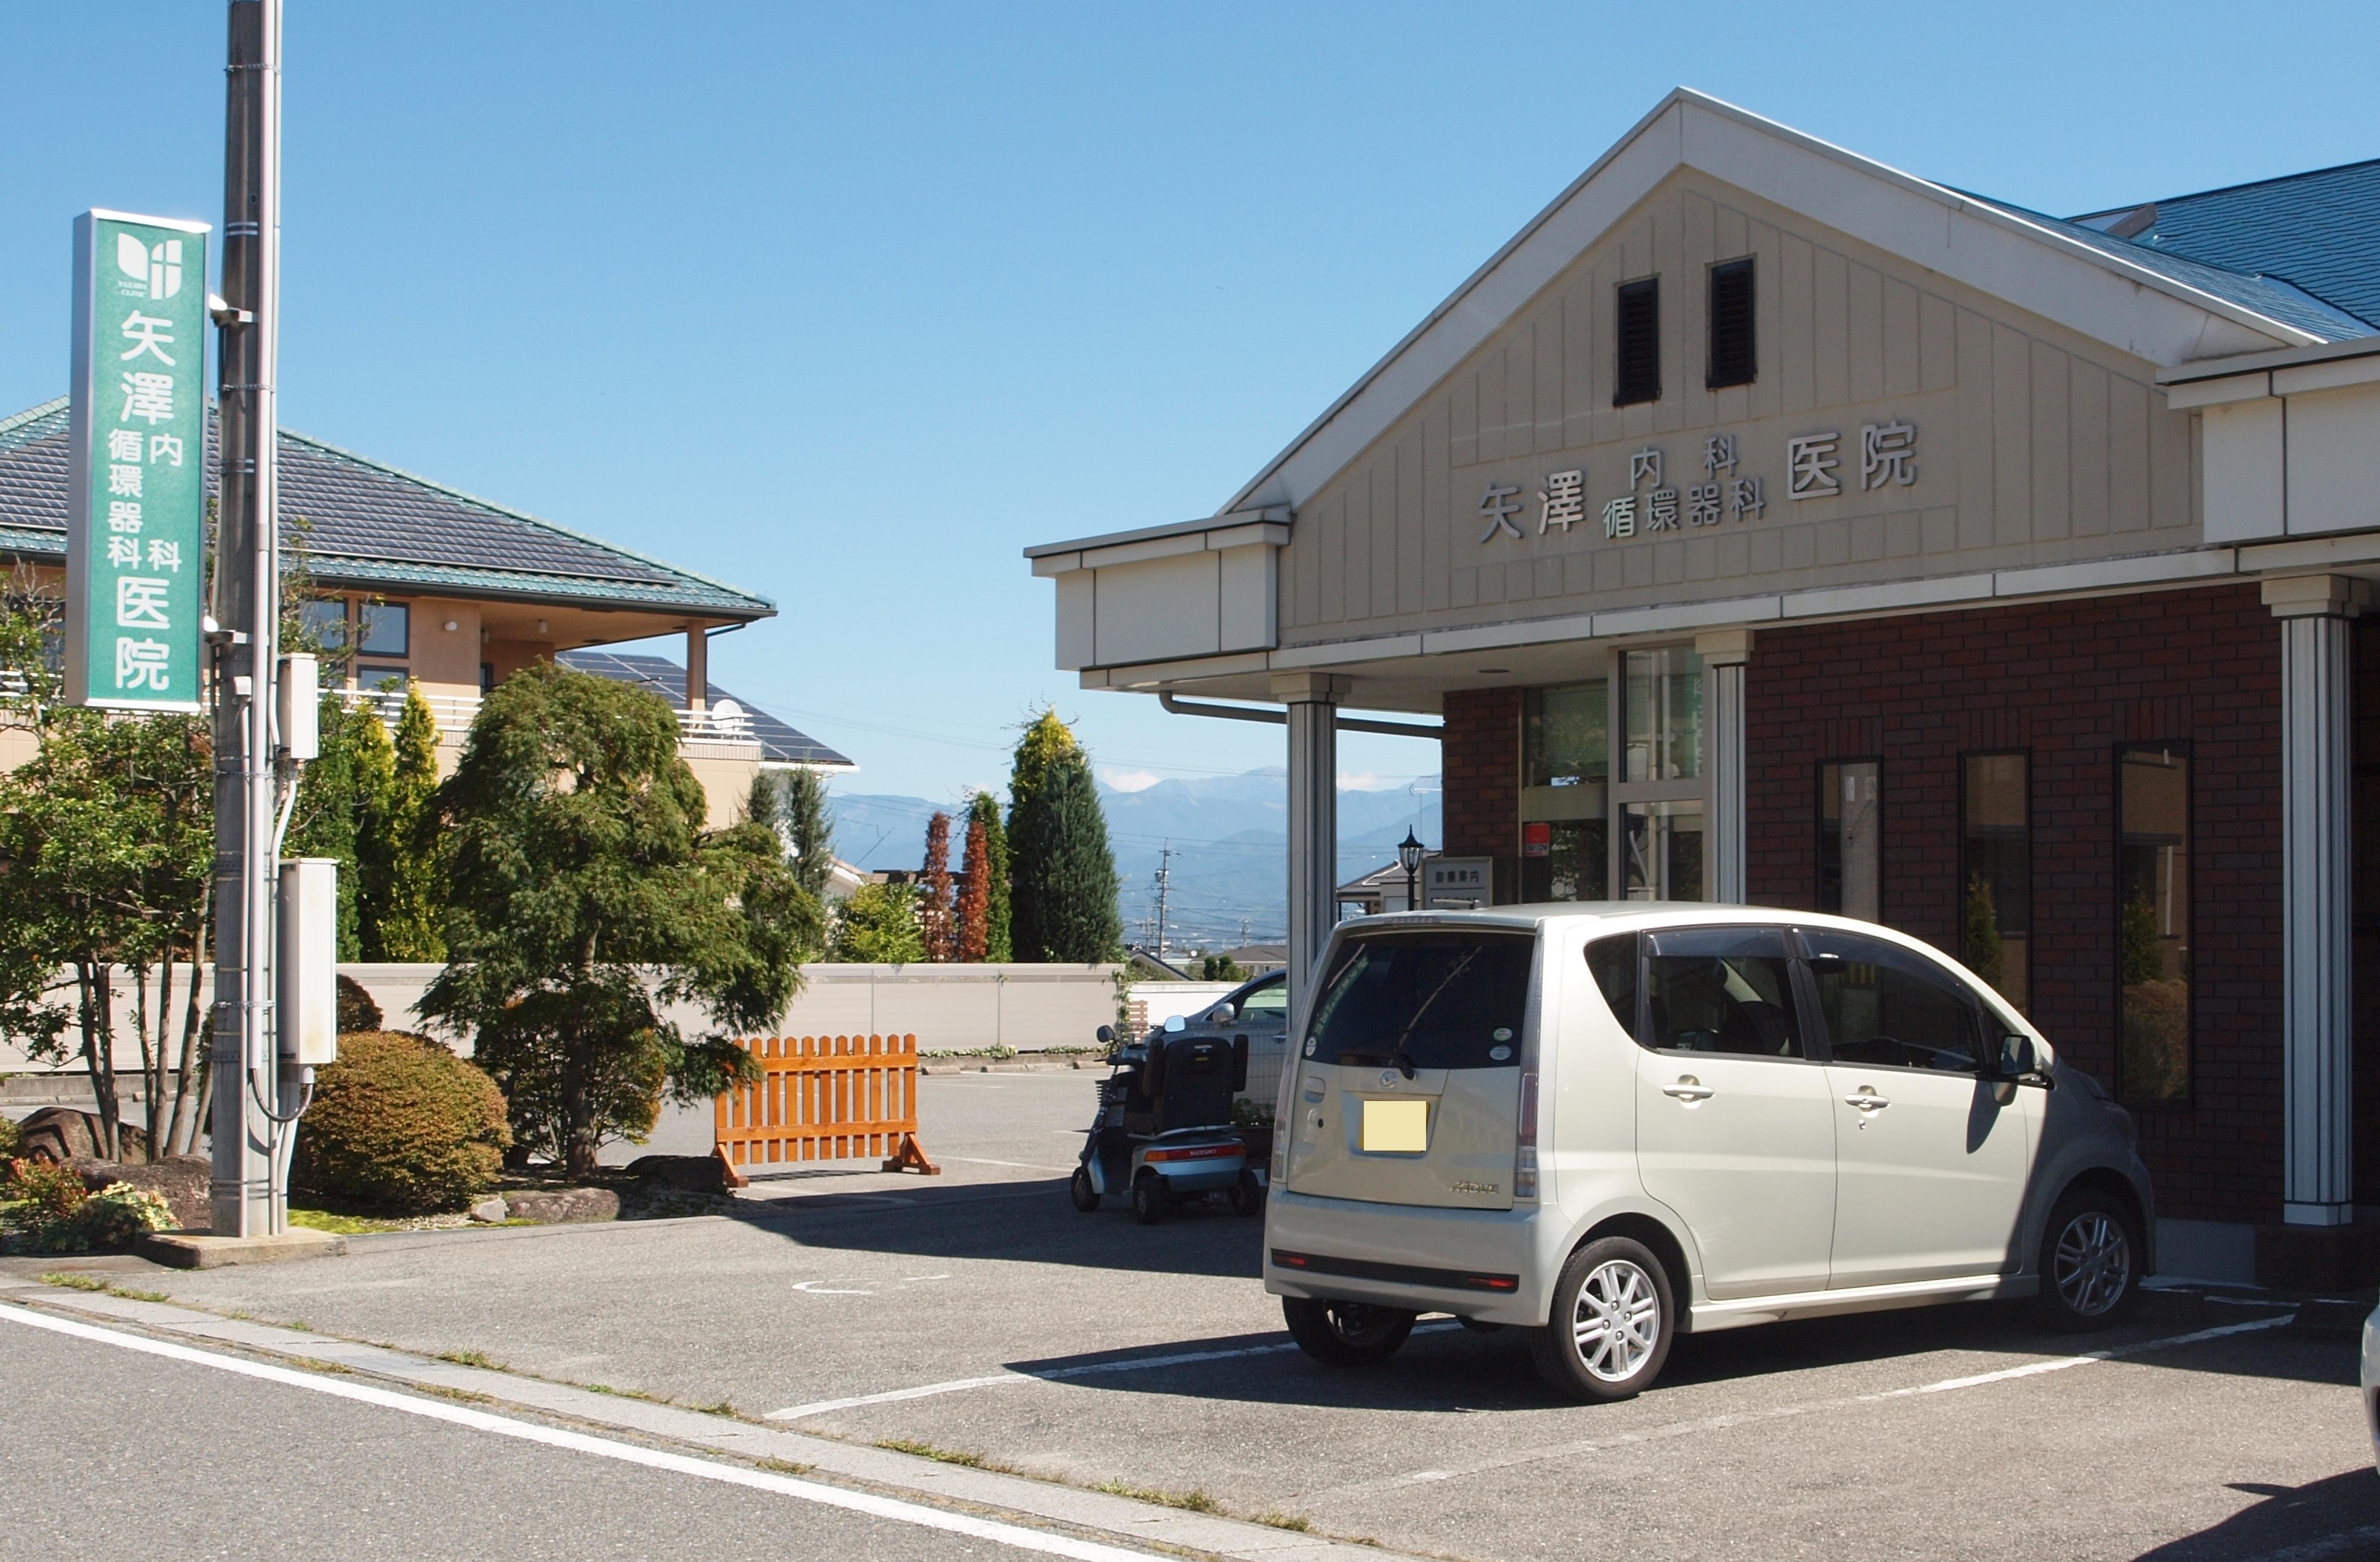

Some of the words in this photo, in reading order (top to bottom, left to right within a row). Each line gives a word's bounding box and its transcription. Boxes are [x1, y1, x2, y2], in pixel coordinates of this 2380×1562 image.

[121, 309, 176, 426] 矢澤
[107, 428, 144, 570] 循環器科
[1478, 469, 1586, 544] 矢澤
[1601, 477, 1766, 539] 循環器科
[1786, 420, 1918, 501] 医院
[115, 576, 171, 691] 医院
